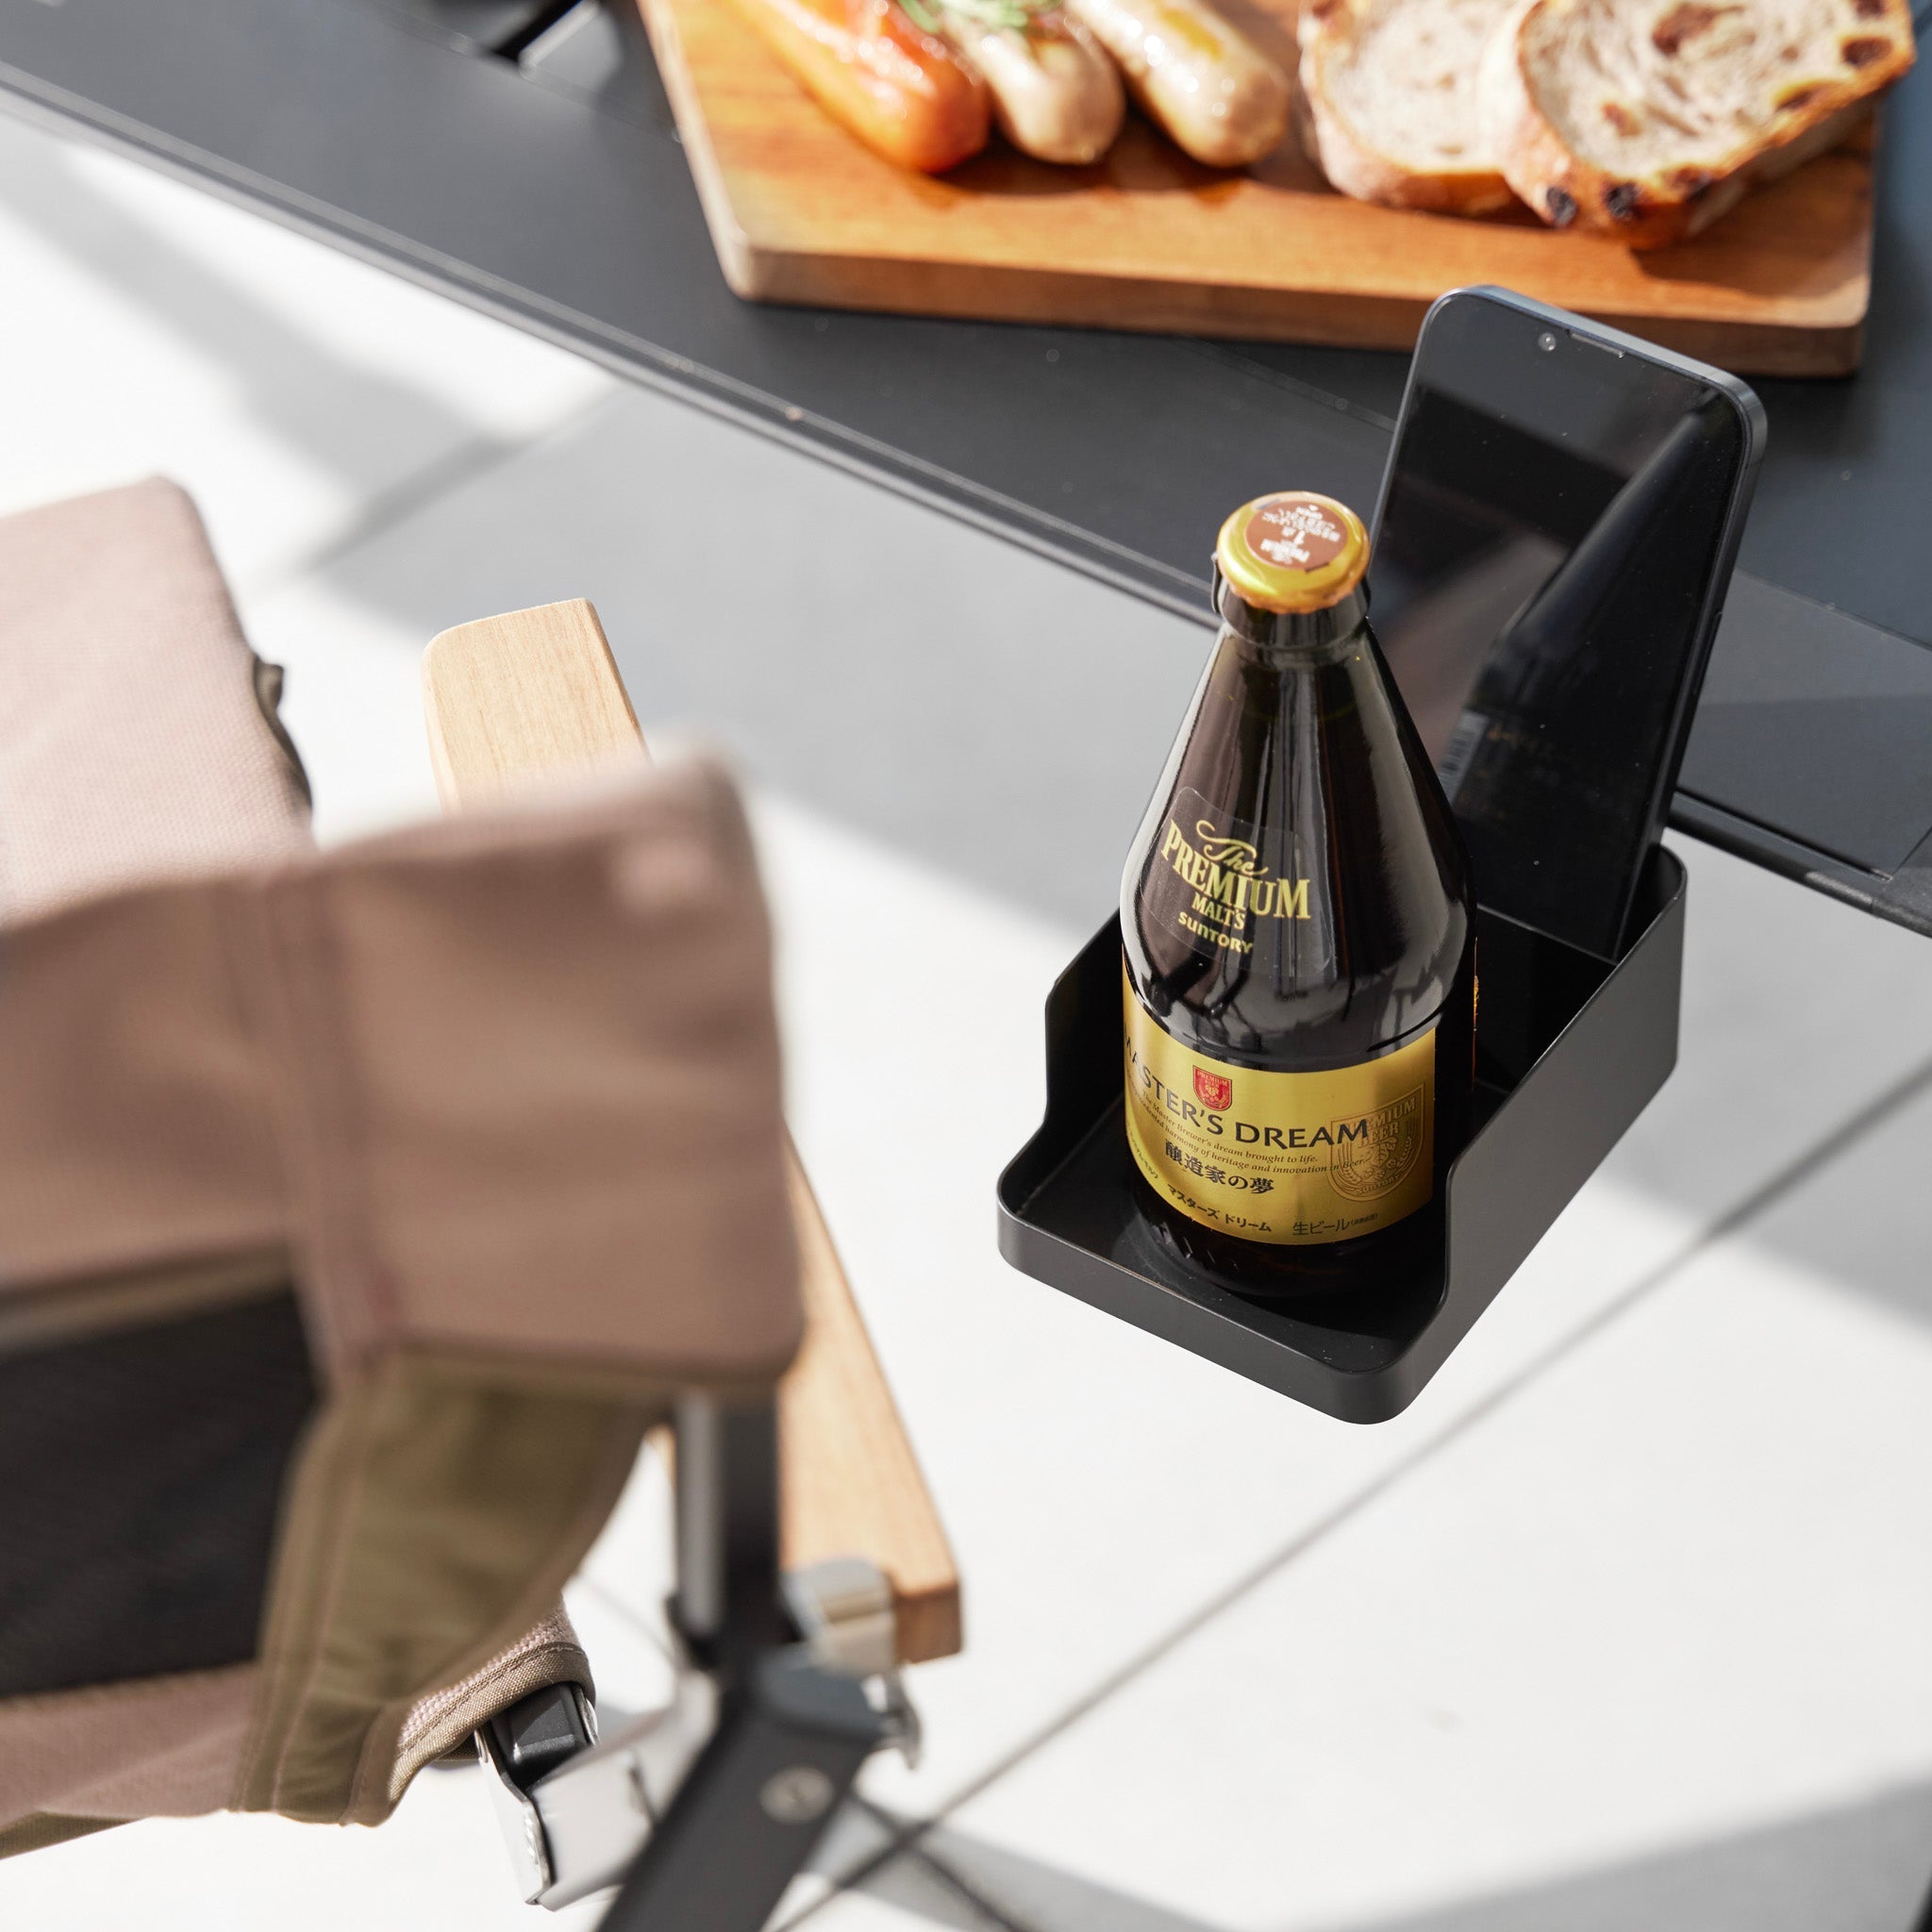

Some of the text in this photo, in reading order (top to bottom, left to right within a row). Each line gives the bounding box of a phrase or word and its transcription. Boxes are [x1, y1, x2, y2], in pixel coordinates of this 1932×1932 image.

[1161, 819, 1311, 919] PREMIUM
[1196, 820, 1268, 875] The
[1178, 911, 1253, 954] SUNTORY
[1191, 892, 1245, 930] MALT'S
[1152, 1102, 1175, 1126] Master
[1176, 1124, 1211, 1147] Brewer's
[1213, 1142, 1243, 1157] dream
[1245, 1151, 1284, 1163] brought
[1299, 1154, 1318, 1165] life.
[1165, 1124, 1199, 1152] harmony
[1201, 1147, 1209, 1158] of
[1211, 1152, 1250, 1170] heritage
[1273, 1165, 1327, 1174] innovation
[1236, 1119, 1368, 1149] DREAM
[1165, 1139, 1274, 1194] 醸造家の夢
[1168, 1183, 1272, 1232] マスターズ ドリーム
[1292, 1219, 1350, 1236] 生ビール
